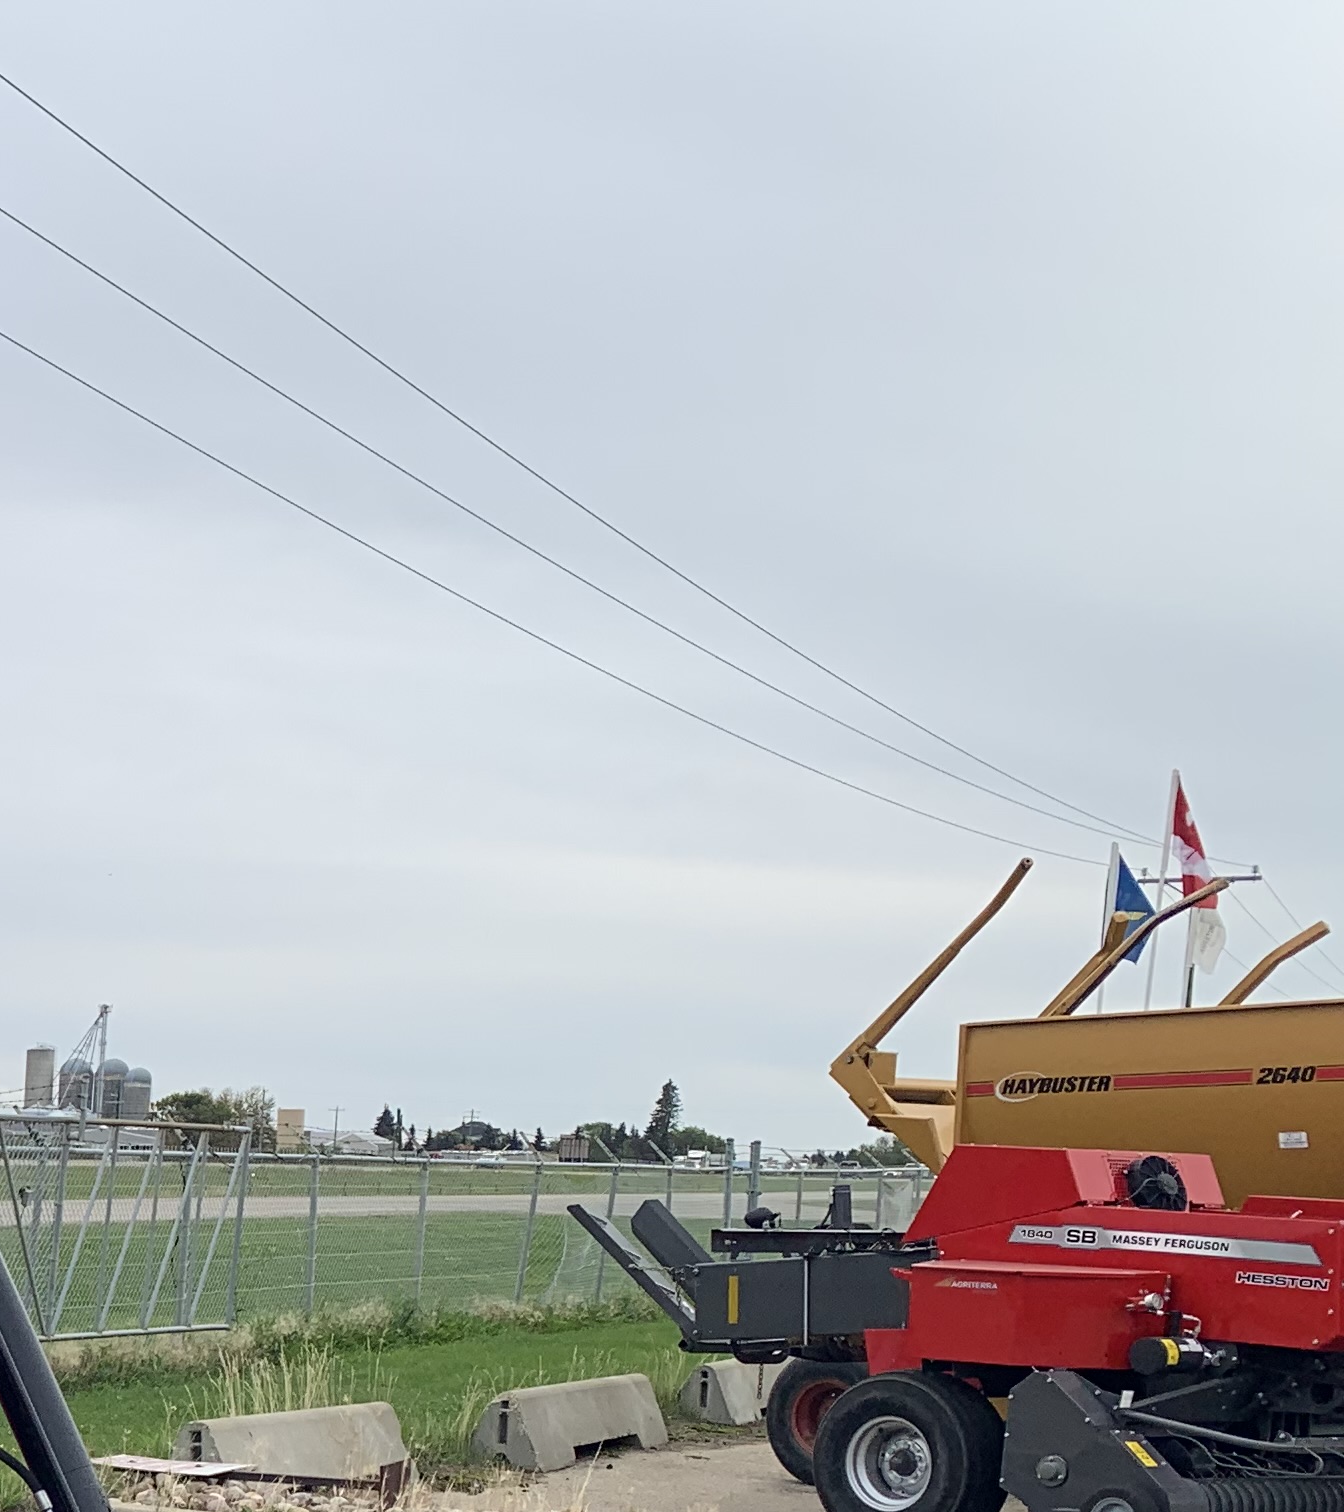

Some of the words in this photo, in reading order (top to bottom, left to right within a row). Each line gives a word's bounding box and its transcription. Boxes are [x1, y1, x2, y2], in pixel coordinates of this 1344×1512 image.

[1001, 1074, 1113, 1096] HAYBUSTER
[1256, 1065, 1317, 1085] 2640
[1020, 1228, 1054, 1240] 1840
[1065, 1228, 1098, 1245] SB
[1111, 1234, 1161, 1247] MASSEY
[1163, 1237, 1231, 1252] FERGUSON
[950, 1280, 998, 1289] AGRITERRA
[1235, 1271, 1330, 1291] HESSTON
